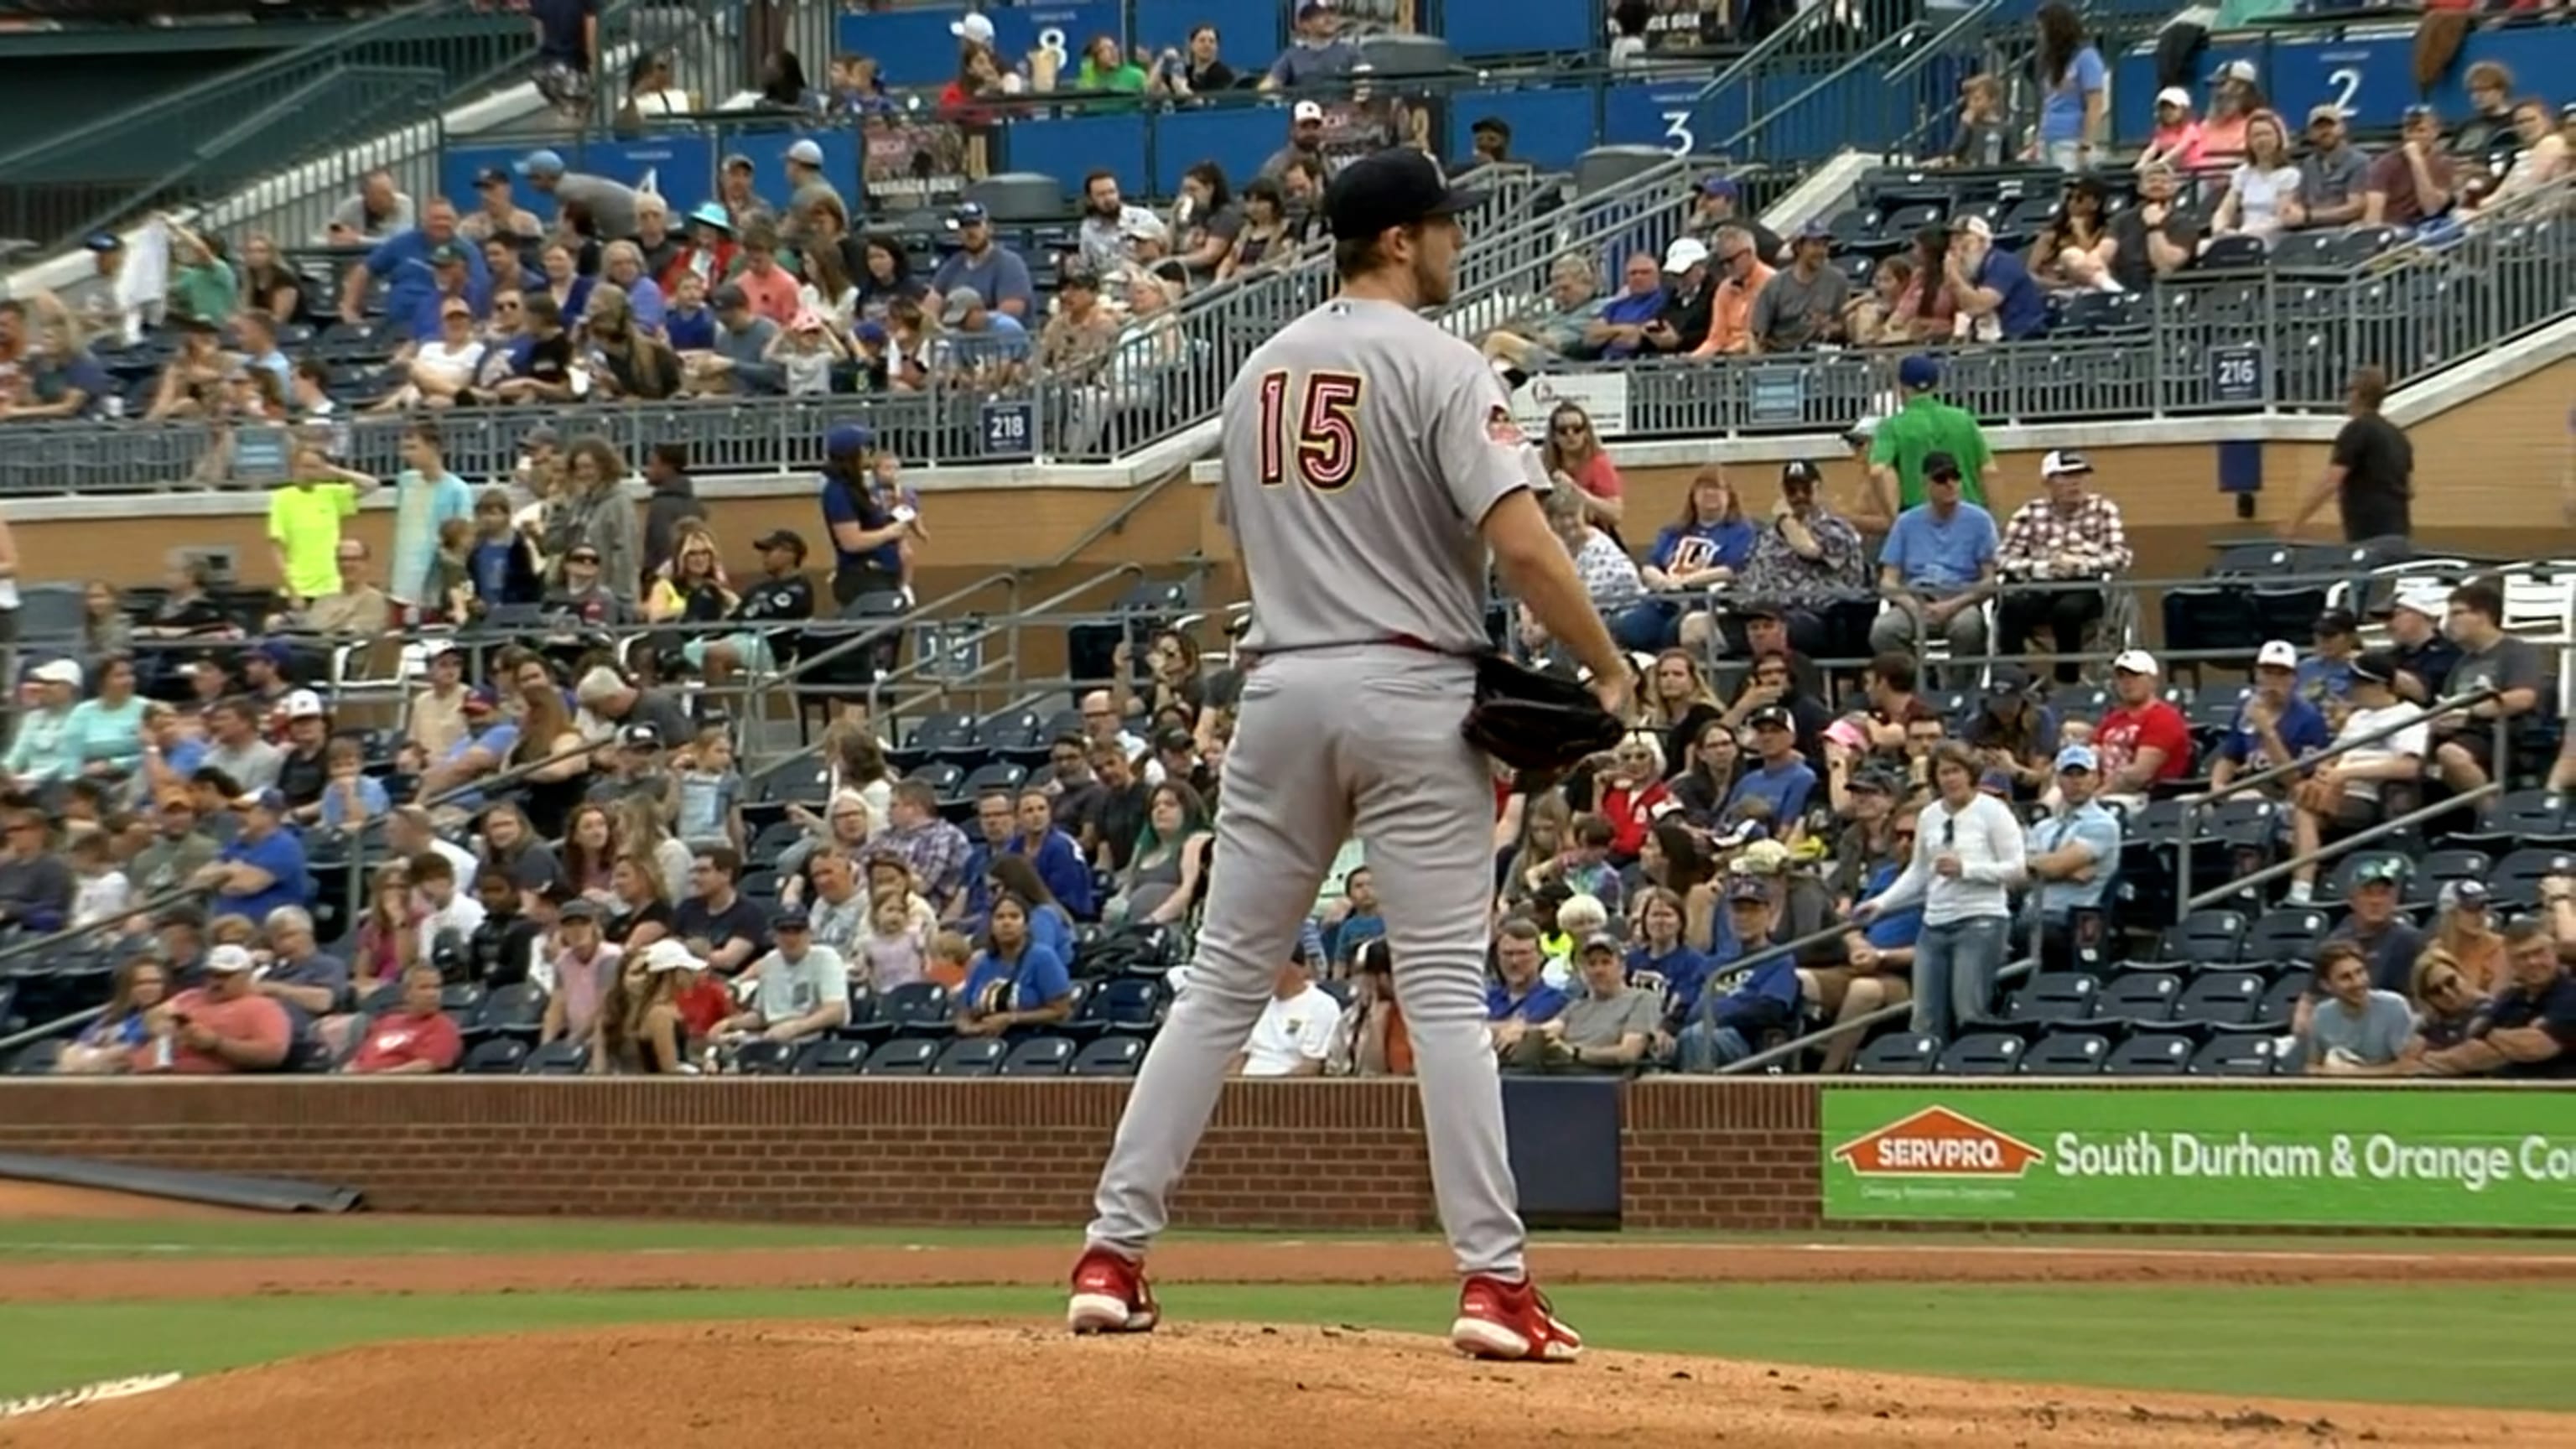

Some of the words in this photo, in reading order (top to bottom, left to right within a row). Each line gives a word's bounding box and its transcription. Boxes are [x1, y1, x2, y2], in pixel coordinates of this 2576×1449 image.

[2329, 69, 2360, 117] 2
[1662, 111, 1694, 158] 3
[2218, 360, 2255, 384] 216
[990, 416, 1025, 438] 218
[1259, 369, 1363, 493] 15
[1877, 1137, 2001, 1167] SERVPRO
[2055, 1131, 2162, 1176] South
[2172, 1131, 2321, 1177] Durham
[2329, 1134, 2357, 1178] &
[2365, 1134, 2514, 1192] Orange
[2519, 1135, 2576, 1181] Co
